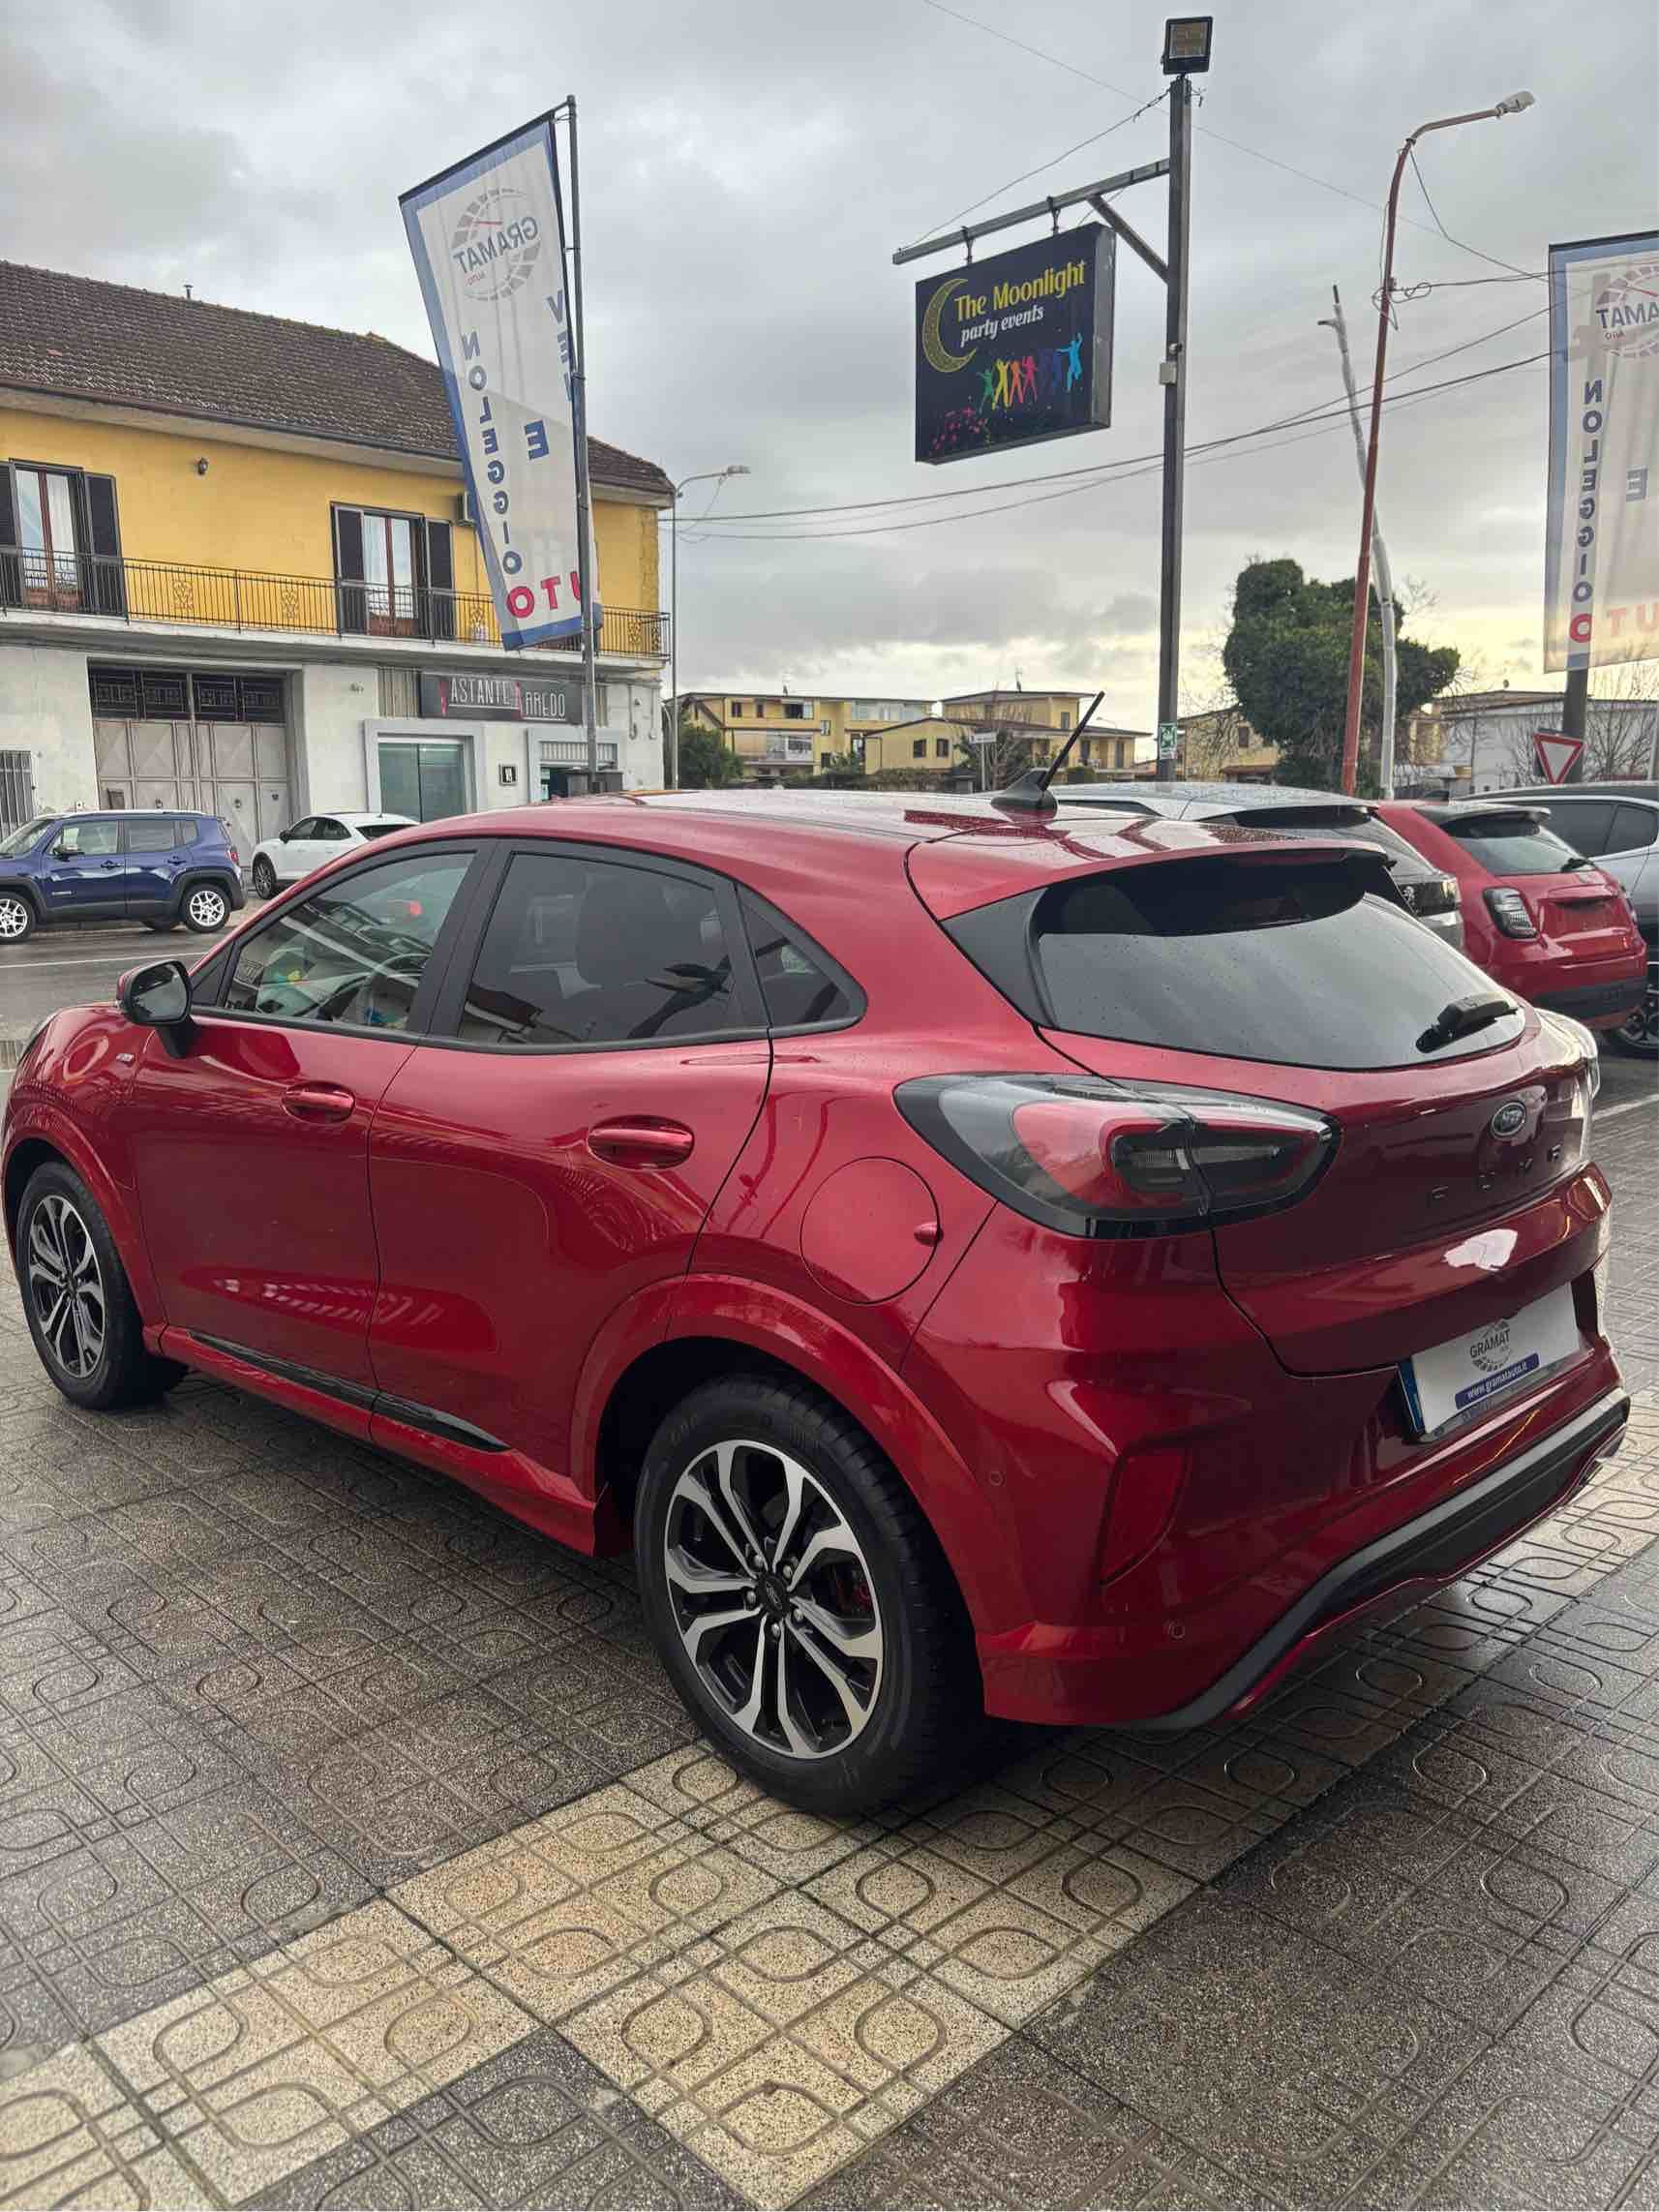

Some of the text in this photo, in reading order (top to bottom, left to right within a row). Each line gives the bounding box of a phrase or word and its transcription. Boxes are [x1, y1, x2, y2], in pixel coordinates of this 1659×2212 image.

[954, 259, 1086, 322] The Moonlight
[960, 304, 1045, 348] party events
[1469, 1328, 1510, 1358] GRAMAT
